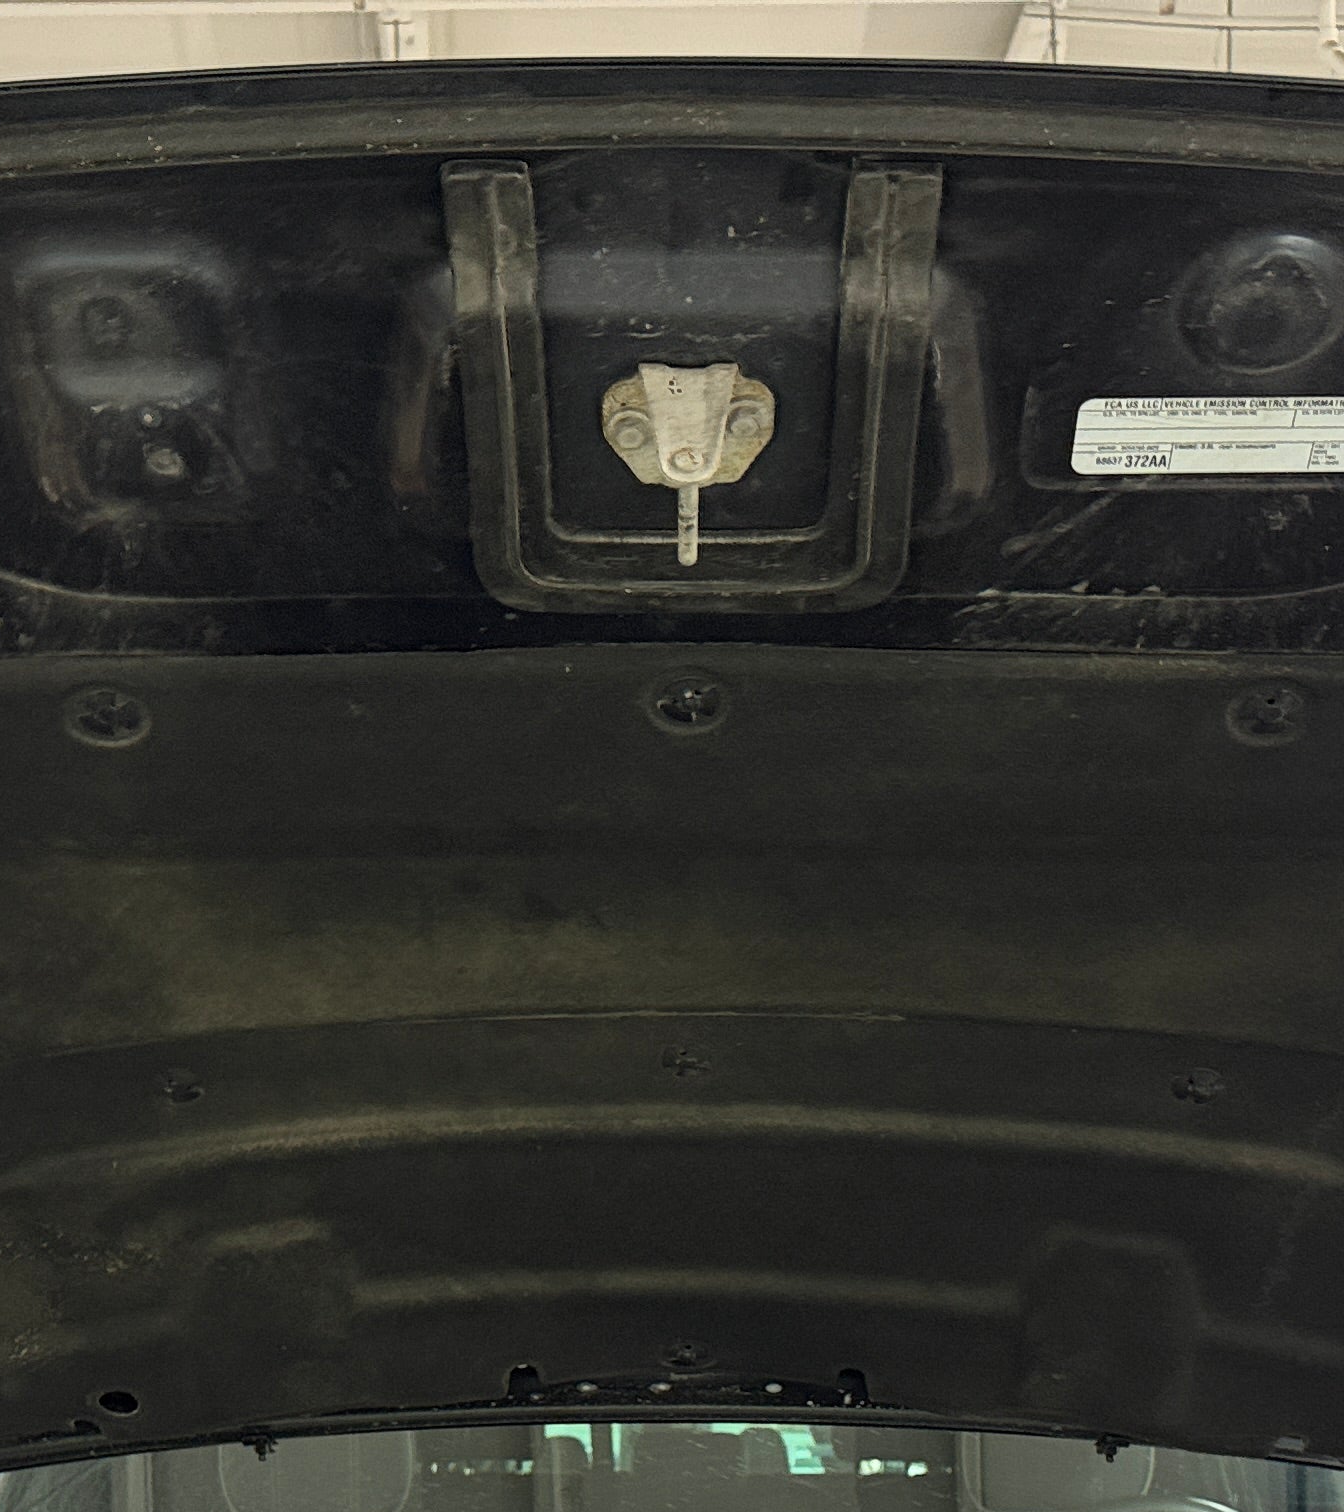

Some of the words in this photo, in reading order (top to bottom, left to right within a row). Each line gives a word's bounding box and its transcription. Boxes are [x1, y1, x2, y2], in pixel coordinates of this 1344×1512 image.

[1104, 400, 1123, 409] FCA
[1125, 400, 1139, 409] US
[1141, 400, 1159, 409] LLC
[1249, 399, 1290, 408] CONTROL
[1124, 455, 1167, 468] 372AA
